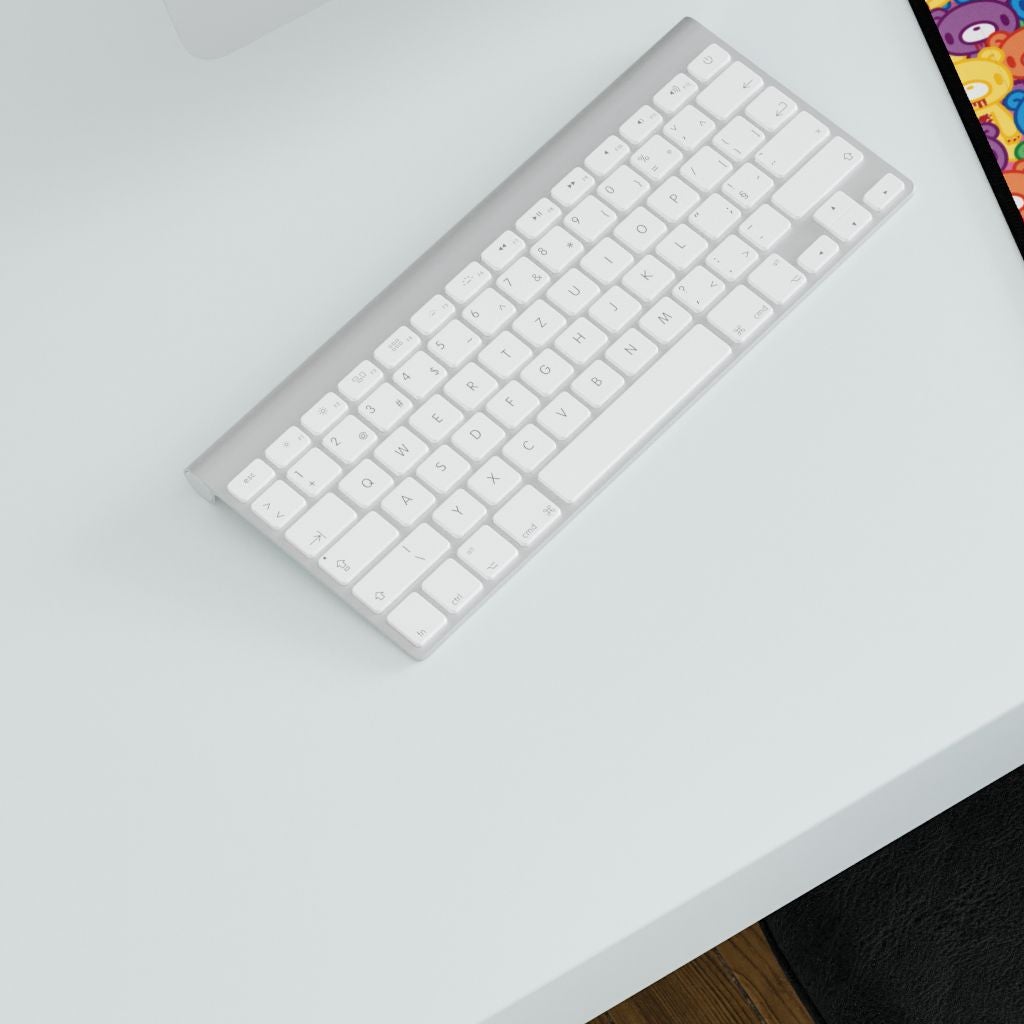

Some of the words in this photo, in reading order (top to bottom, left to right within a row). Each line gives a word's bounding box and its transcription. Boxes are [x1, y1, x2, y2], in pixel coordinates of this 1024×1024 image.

[668, 193, 679, 204] P
[570, 216, 581, 225] 9
[636, 223, 648, 234] O
[537, 247, 548, 256] 8
[673, 241, 687, 250] L
[639, 269, 654, 281] K
[502, 277, 512, 288] 7
[567, 284, 581, 297] U
[608, 301, 619, 312] J
[470, 309, 480, 319] 6
[657, 311, 673, 326] M
[534, 316, 548, 329] Z
[571, 331, 587, 345] H
[434, 340, 446, 351] 5
[623, 343, 638, 356] N
[499, 347, 512, 359] T
[539, 363, 552, 375] G
[402, 371, 412, 381] 4
[590, 375, 603, 388] B
[465, 380, 479, 392] R
[504, 396, 515, 408] F
[365, 404, 376, 415] 3
[554, 407, 568, 418] V
[431, 412, 444, 424] E
[469, 429, 482, 441] D
[329, 436, 342, 447] 2
[520, 440, 535, 451] C
[393, 443, 410, 457] W
[434, 461, 448, 472] S
[293, 469, 305, 479] 1
[486, 471, 501, 486] X
[360, 477, 375, 489] Q
[400, 495, 414, 507] A
[450, 504, 464, 516] Y
[520, 522, 539, 539] cmd
